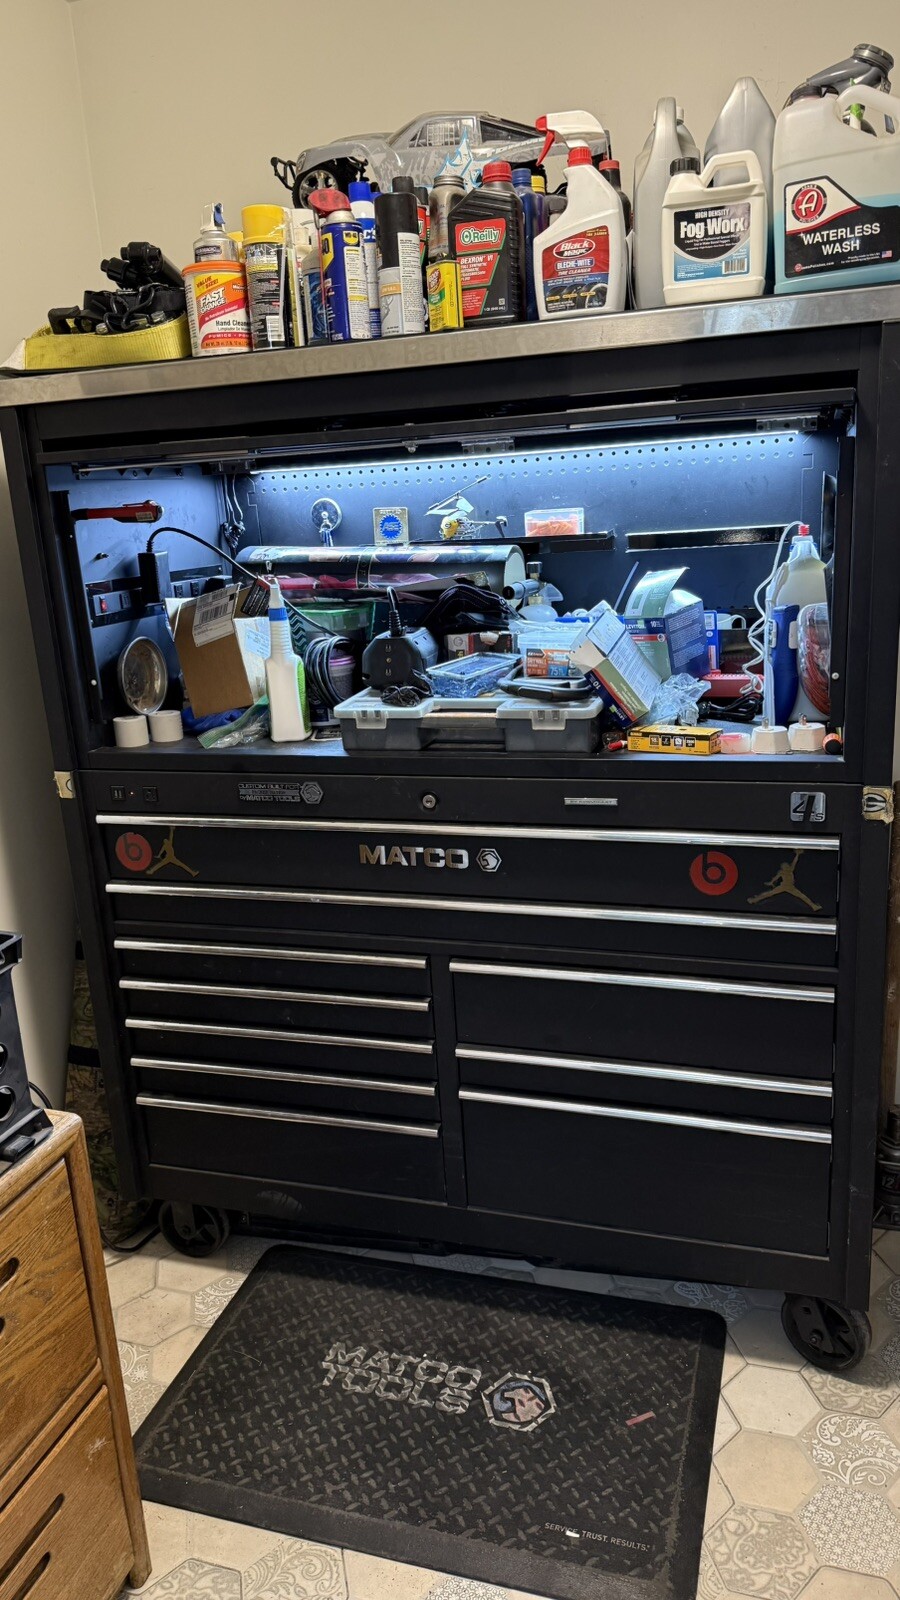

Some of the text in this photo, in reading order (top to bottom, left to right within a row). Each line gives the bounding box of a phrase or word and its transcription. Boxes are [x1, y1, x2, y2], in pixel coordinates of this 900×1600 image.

[694, 208, 730, 219] HIGH DENSITY
[462, 228, 500, 244] O'Reilly
[802, 222, 880, 246] WATERLESS
[561, 240, 590, 251] Black
[822, 239, 860, 256] WASH
[196, 275, 212, 288] VALUE
[200, 287, 225, 307] FAST
[359, 844, 469, 869] MATCO
[324, 1342, 482, 1391] MATCO
[322, 1362, 472, 1414] TOOLS
[582, 1530, 608, 1543] TRUST.
